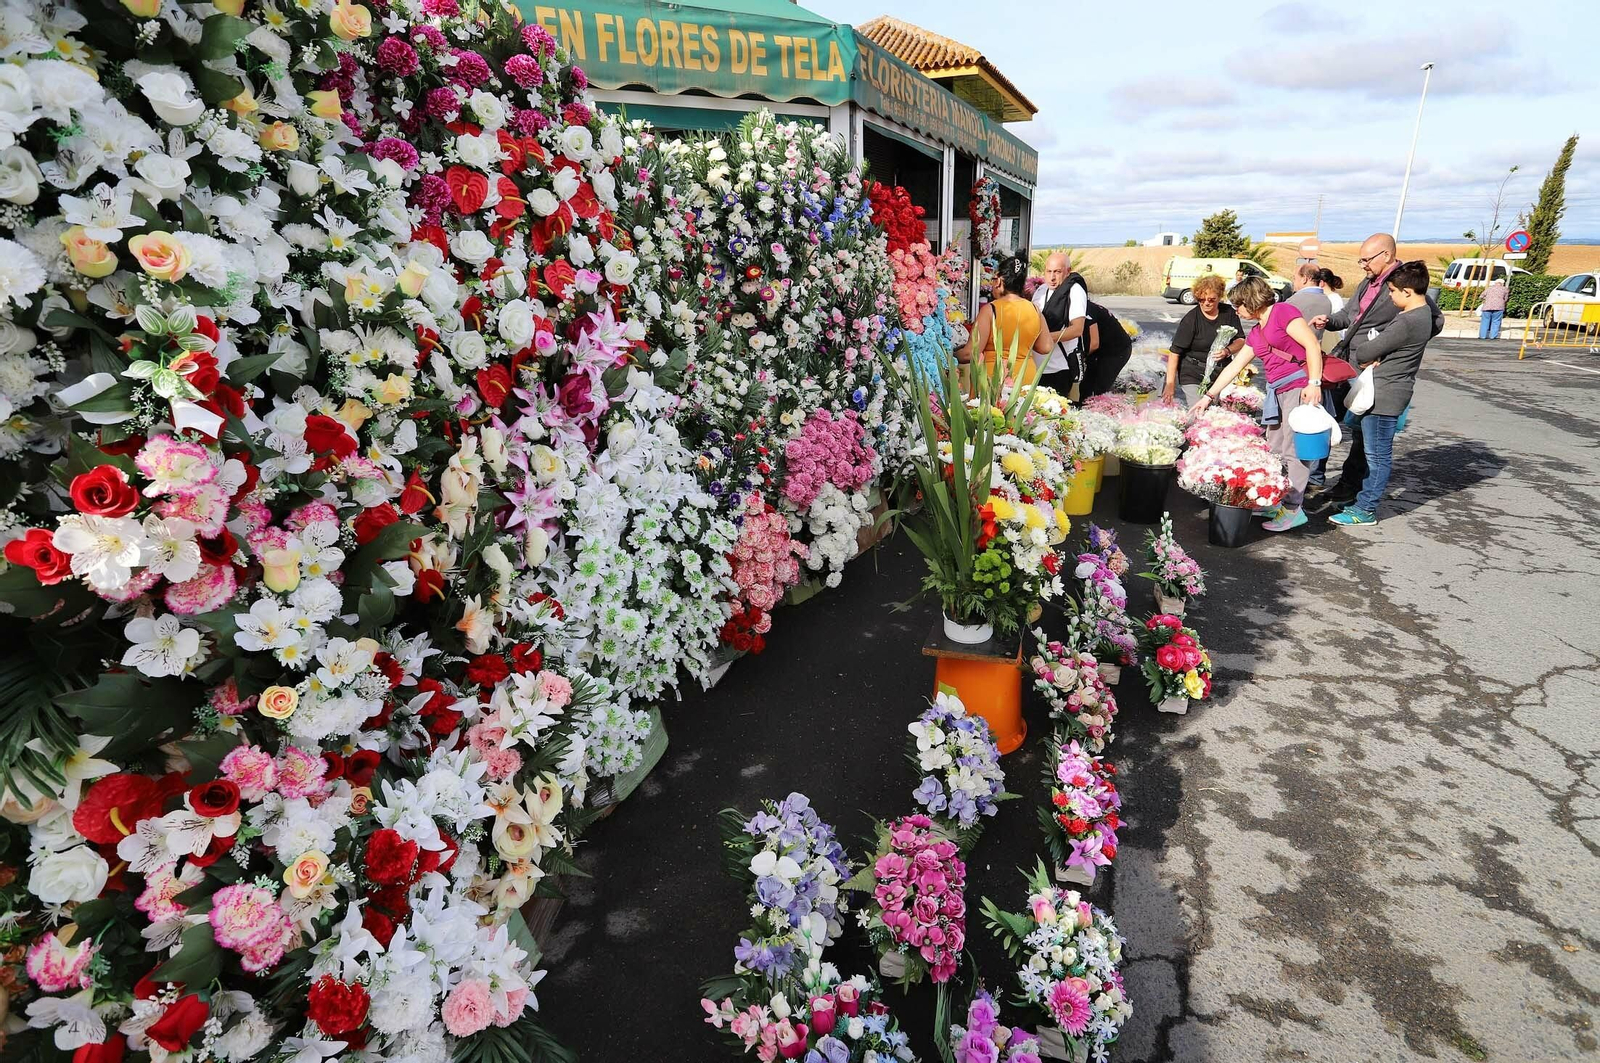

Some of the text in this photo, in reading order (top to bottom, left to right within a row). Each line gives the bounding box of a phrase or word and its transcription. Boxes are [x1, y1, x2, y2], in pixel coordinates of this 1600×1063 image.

[534, 5, 586, 61] EN
[594, 12, 721, 72] FLORES
[728, 28, 768, 77] DE
[773, 35, 847, 82] TELA
[857, 42, 949, 122] FLORISTERIA
